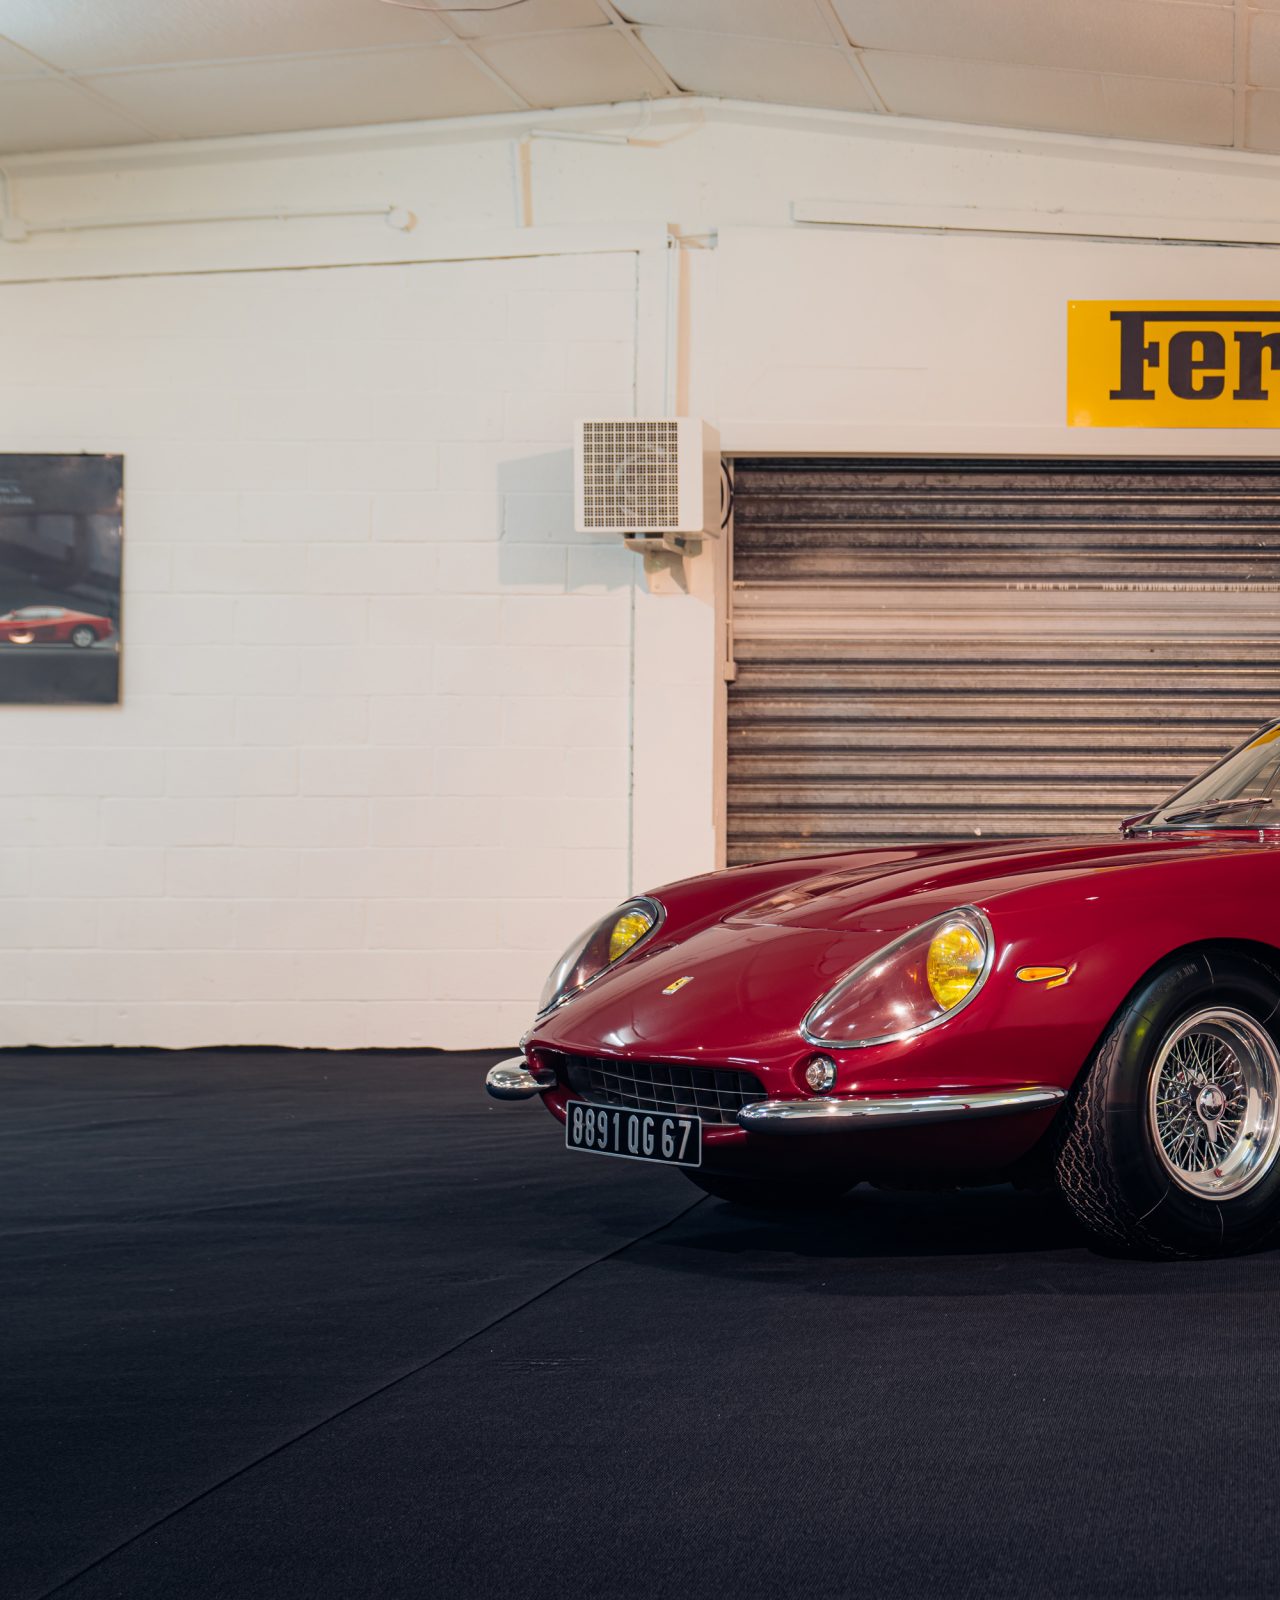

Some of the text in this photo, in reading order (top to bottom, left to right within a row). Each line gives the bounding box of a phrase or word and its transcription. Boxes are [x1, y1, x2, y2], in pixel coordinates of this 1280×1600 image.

[573, 1106, 691, 1160] 8891 QG 67
